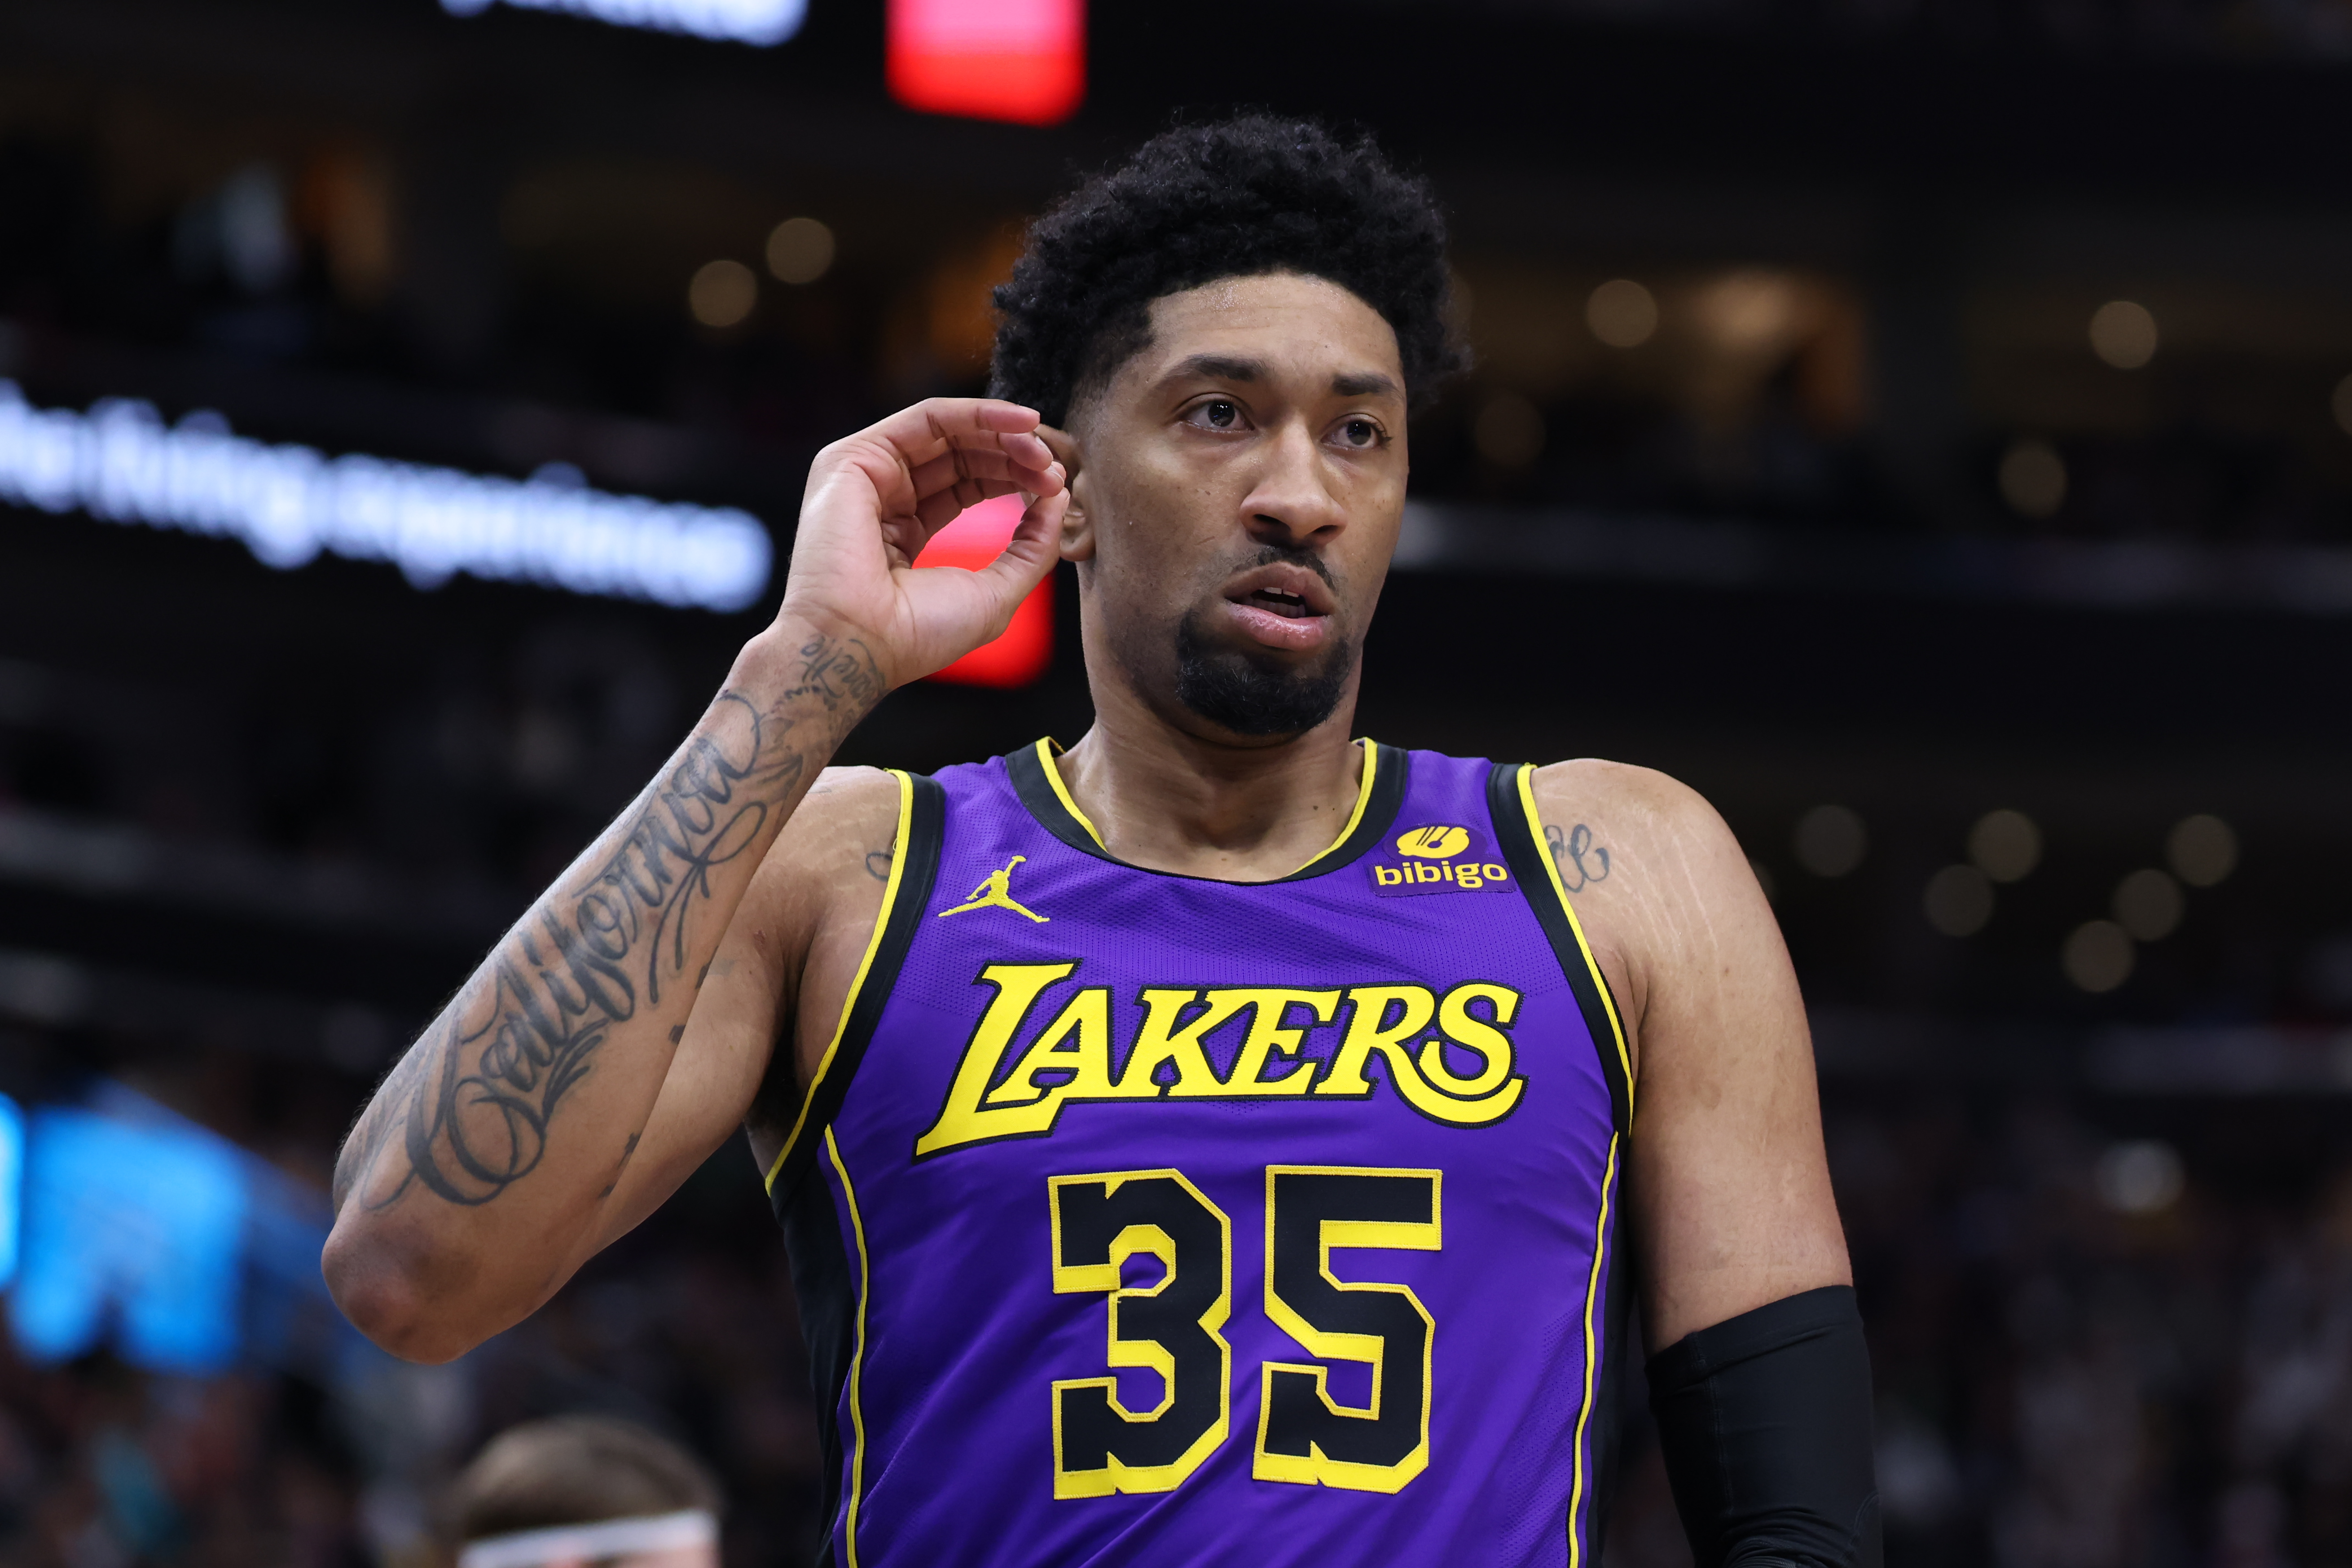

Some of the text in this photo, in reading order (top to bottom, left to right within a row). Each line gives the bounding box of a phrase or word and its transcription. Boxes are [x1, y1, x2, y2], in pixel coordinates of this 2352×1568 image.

[360, 692, 767, 1209] California
[1375, 861, 1508, 888] bibigo
[912, 957, 1530, 1164] LAKERS
[1048, 1164, 1442, 1500] 35
